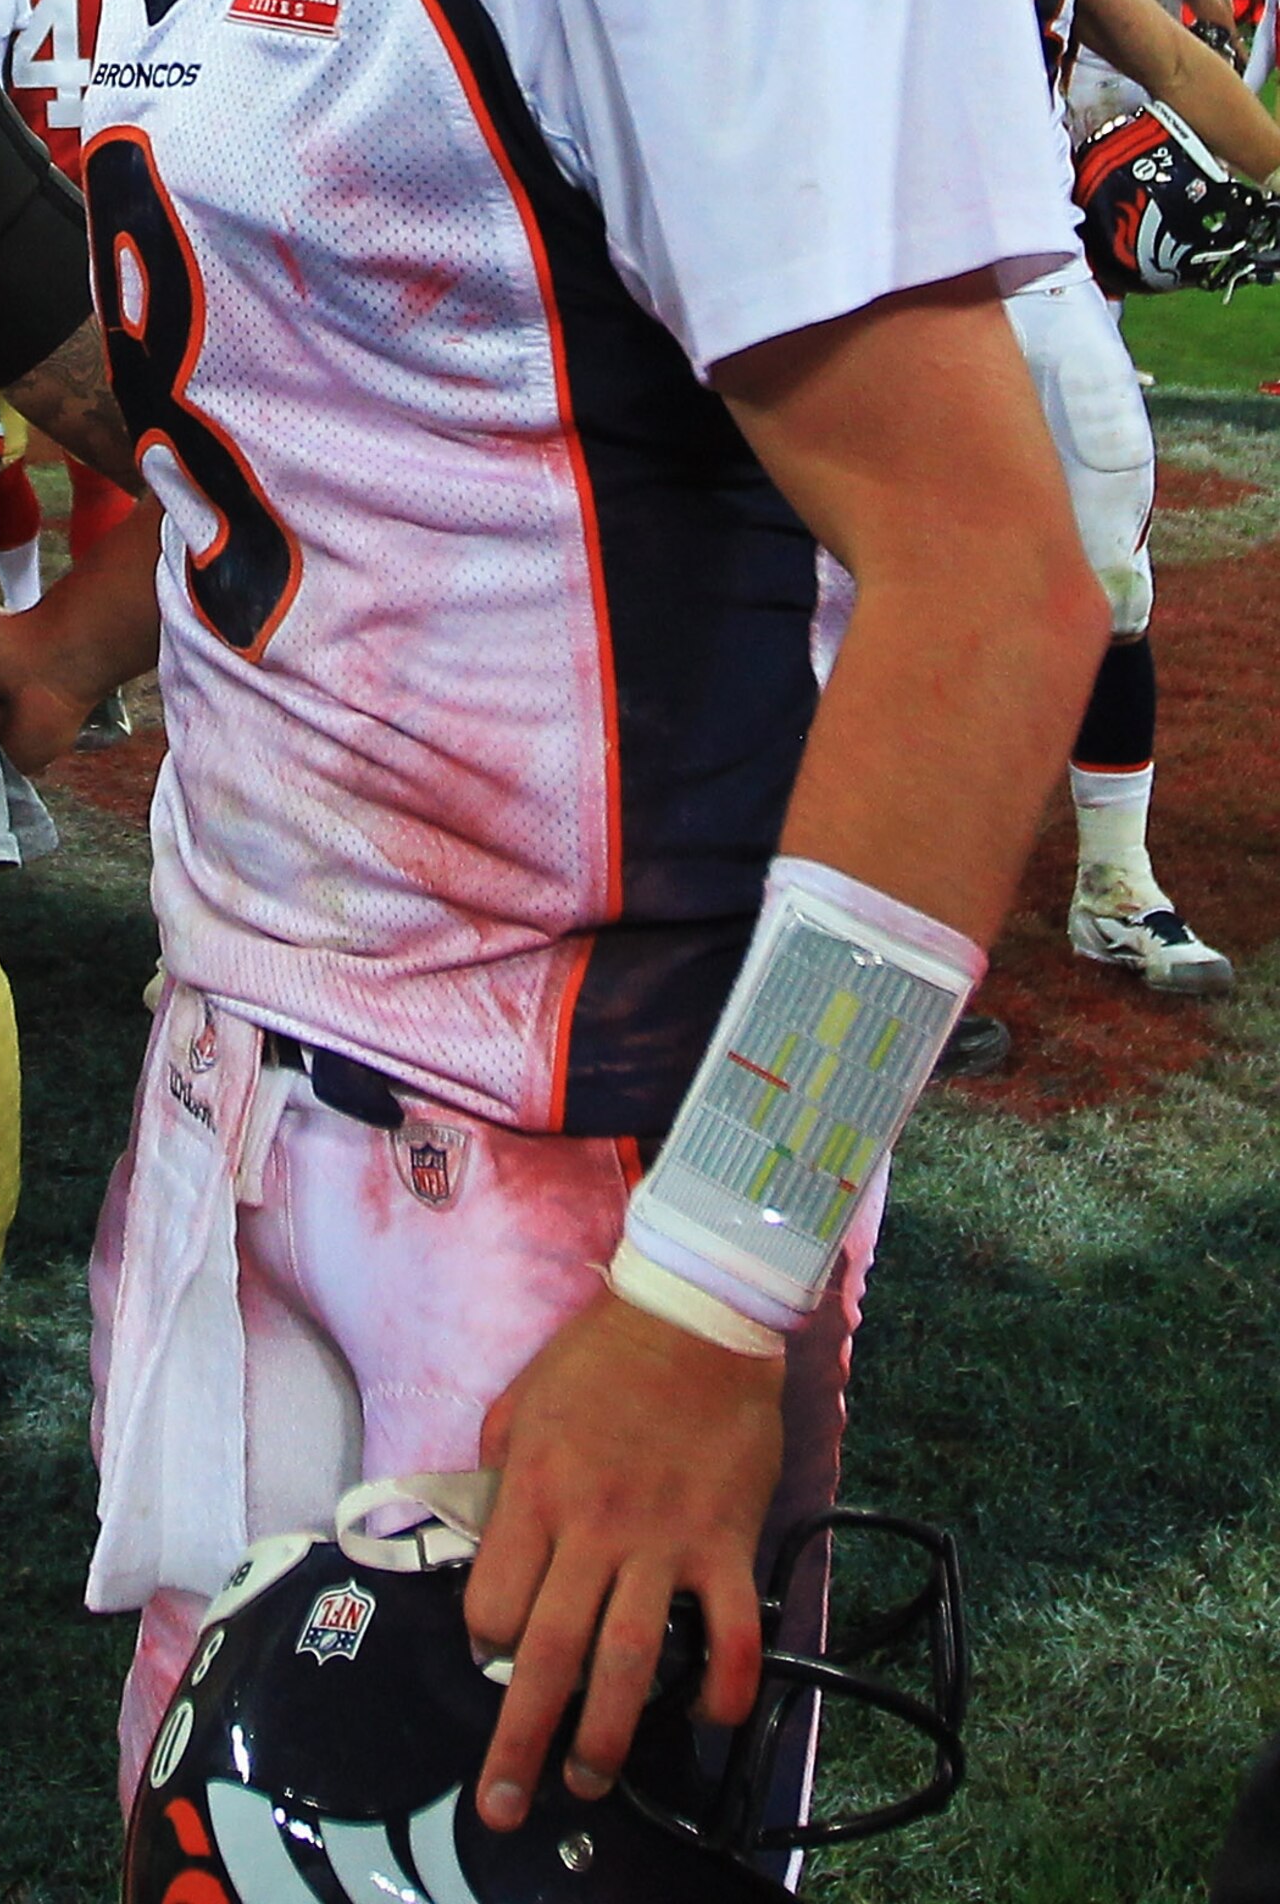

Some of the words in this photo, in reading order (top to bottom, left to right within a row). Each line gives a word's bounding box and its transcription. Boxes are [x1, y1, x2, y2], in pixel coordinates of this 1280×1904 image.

[91, 62, 202, 89] BRONCOS
[80, 124, 304, 665] 8
[320, 1596, 366, 1632] NFL
